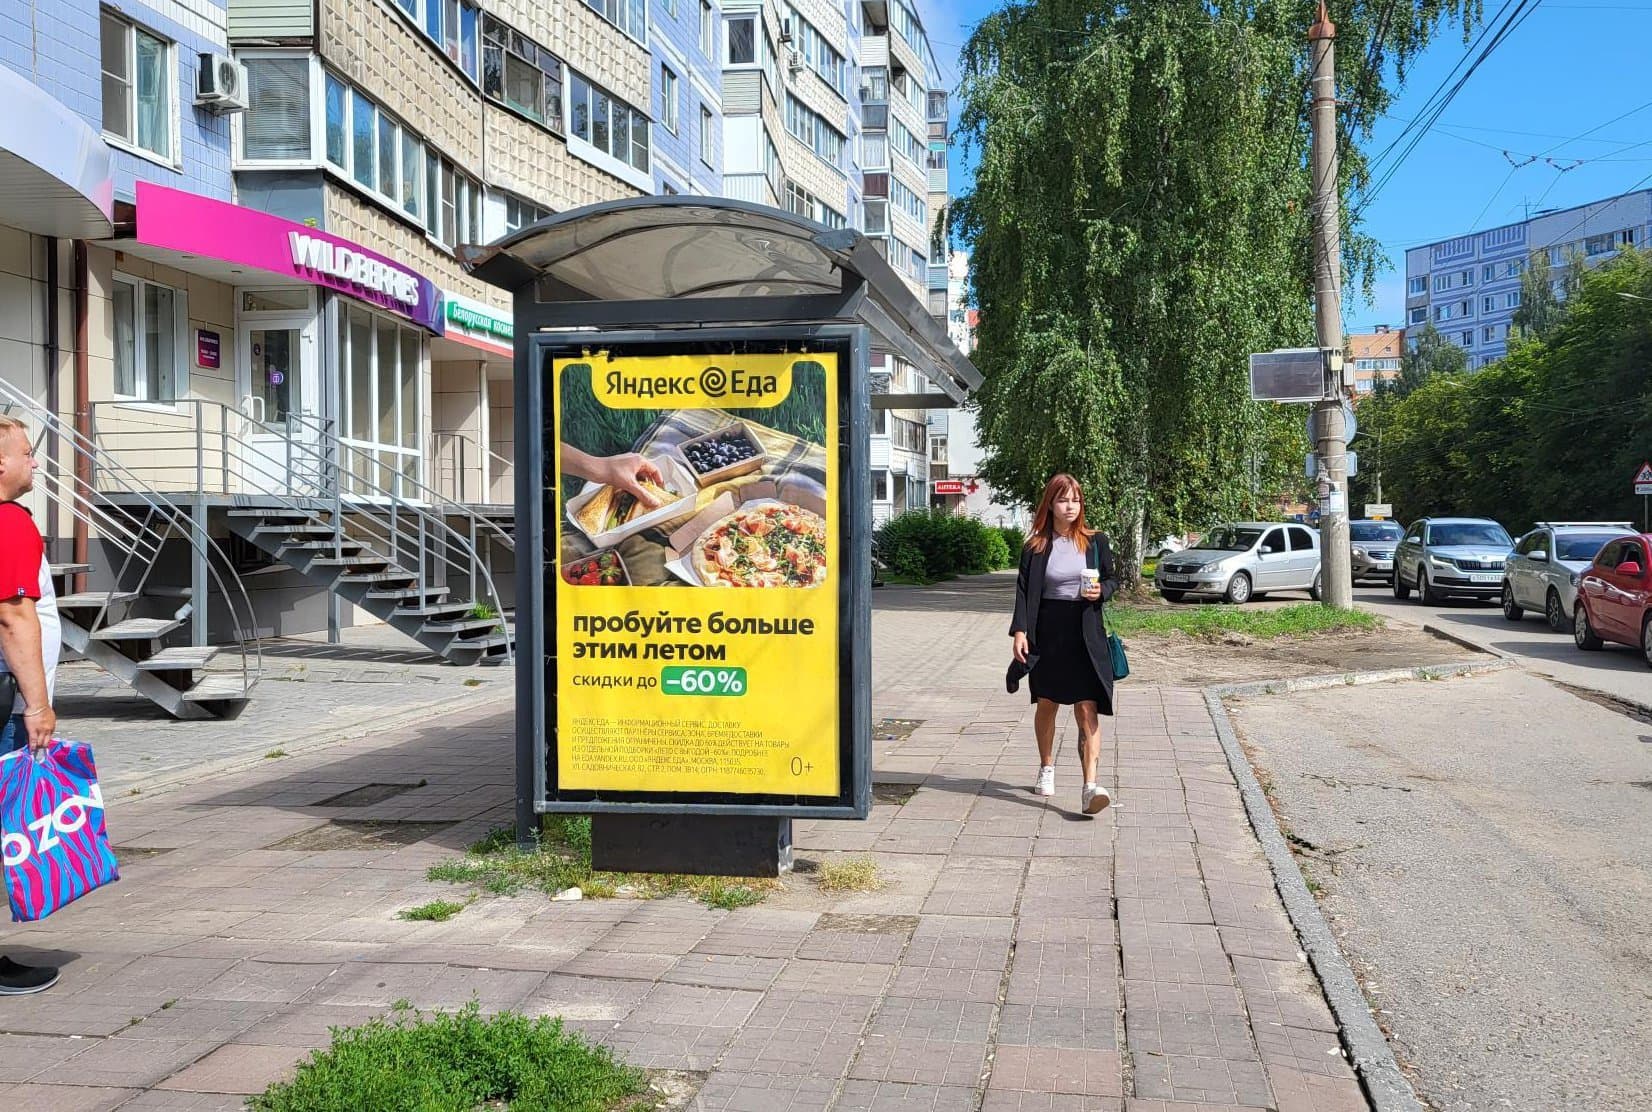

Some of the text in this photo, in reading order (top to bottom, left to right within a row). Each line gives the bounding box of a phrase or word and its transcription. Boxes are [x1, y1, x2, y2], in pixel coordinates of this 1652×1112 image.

[288, 231, 419, 306] WILDBERRIES
[453, 303, 492, 331] Белорусская
[606, 370, 777, 398] Яндекс Еда
[573, 610, 815, 638] пробуйте больше
[573, 641, 726, 660] этим летом
[572, 669, 743, 693] скидки до -60%
[791, 756, 814, 777] 0+
